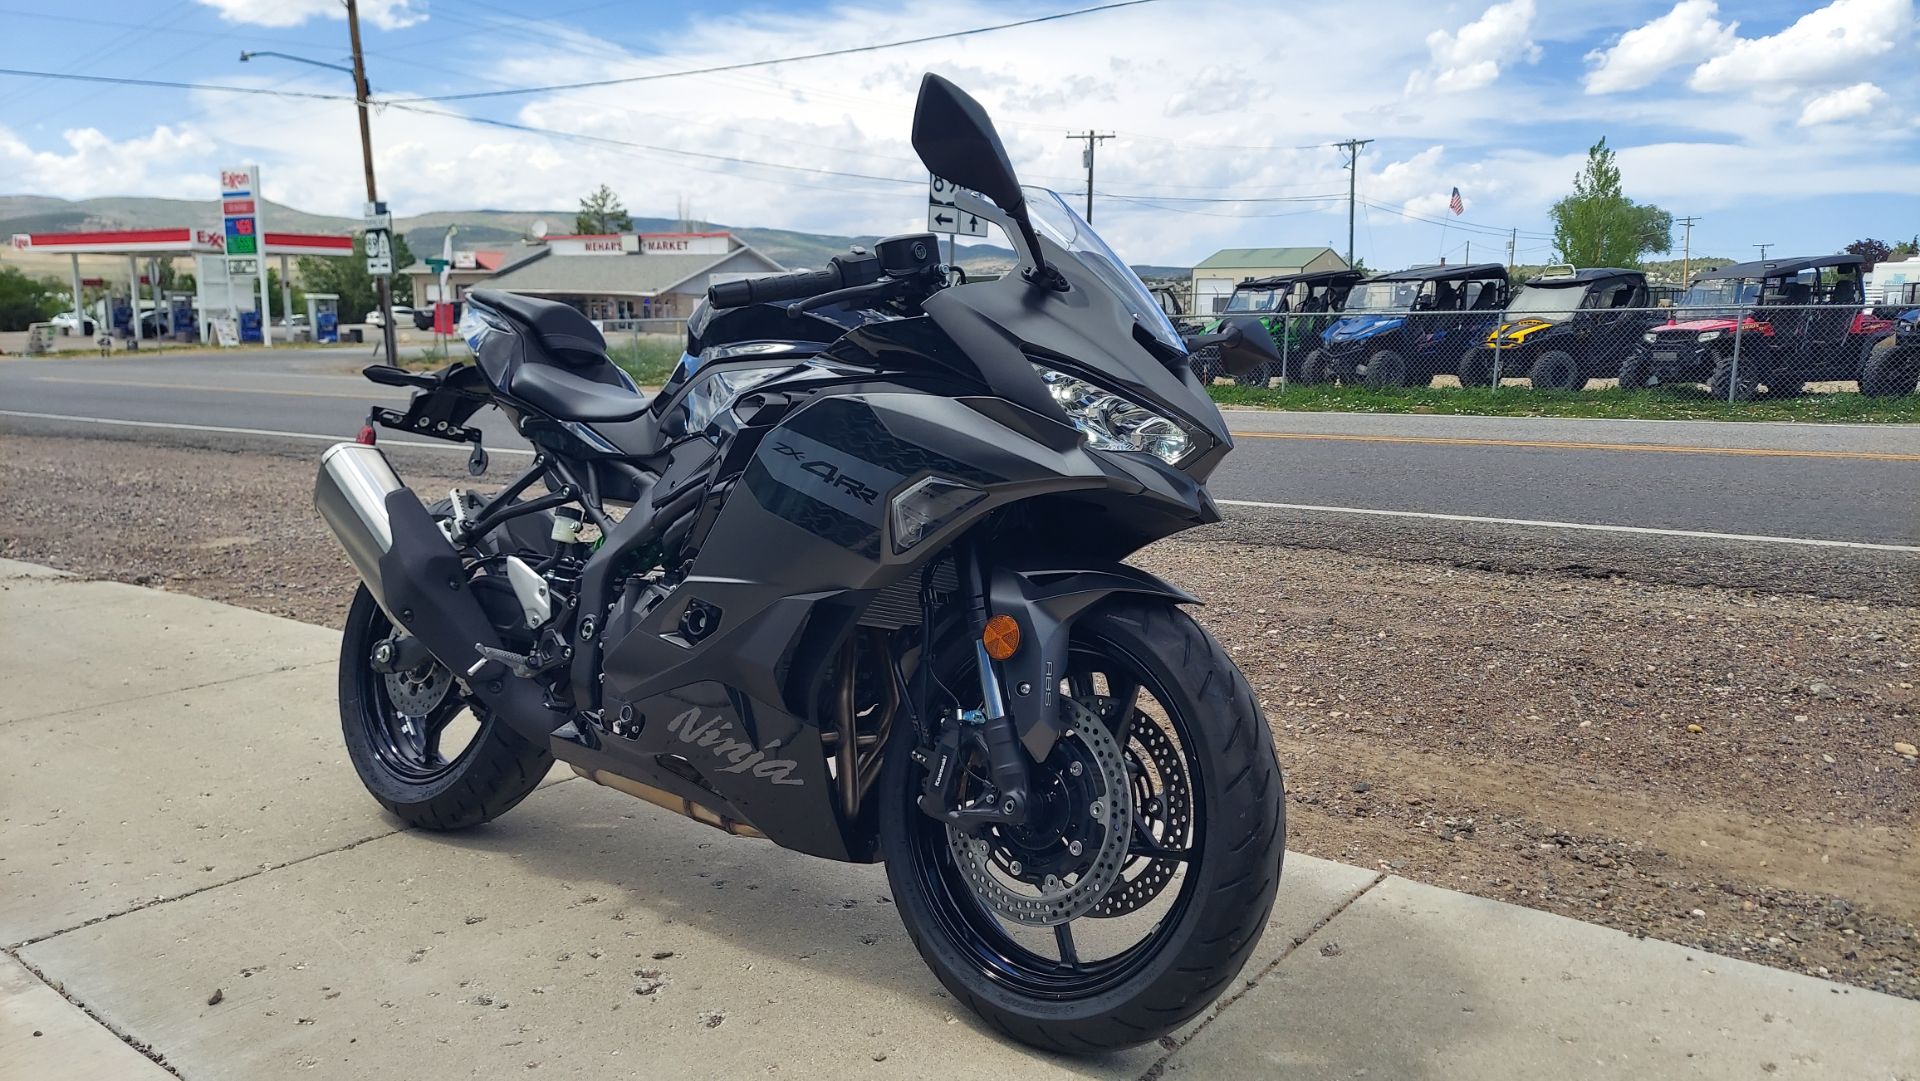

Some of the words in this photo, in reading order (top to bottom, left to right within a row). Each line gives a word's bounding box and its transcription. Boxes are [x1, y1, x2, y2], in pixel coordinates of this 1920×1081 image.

[222, 171, 249, 188] Exxon
[197, 230, 224, 248] Exx
[648, 241, 689, 251] MARKET
[1044, 661, 1053, 707] ABS
[667, 706, 804, 785] Ninja
[934, 754, 948, 787] Kawasaki
